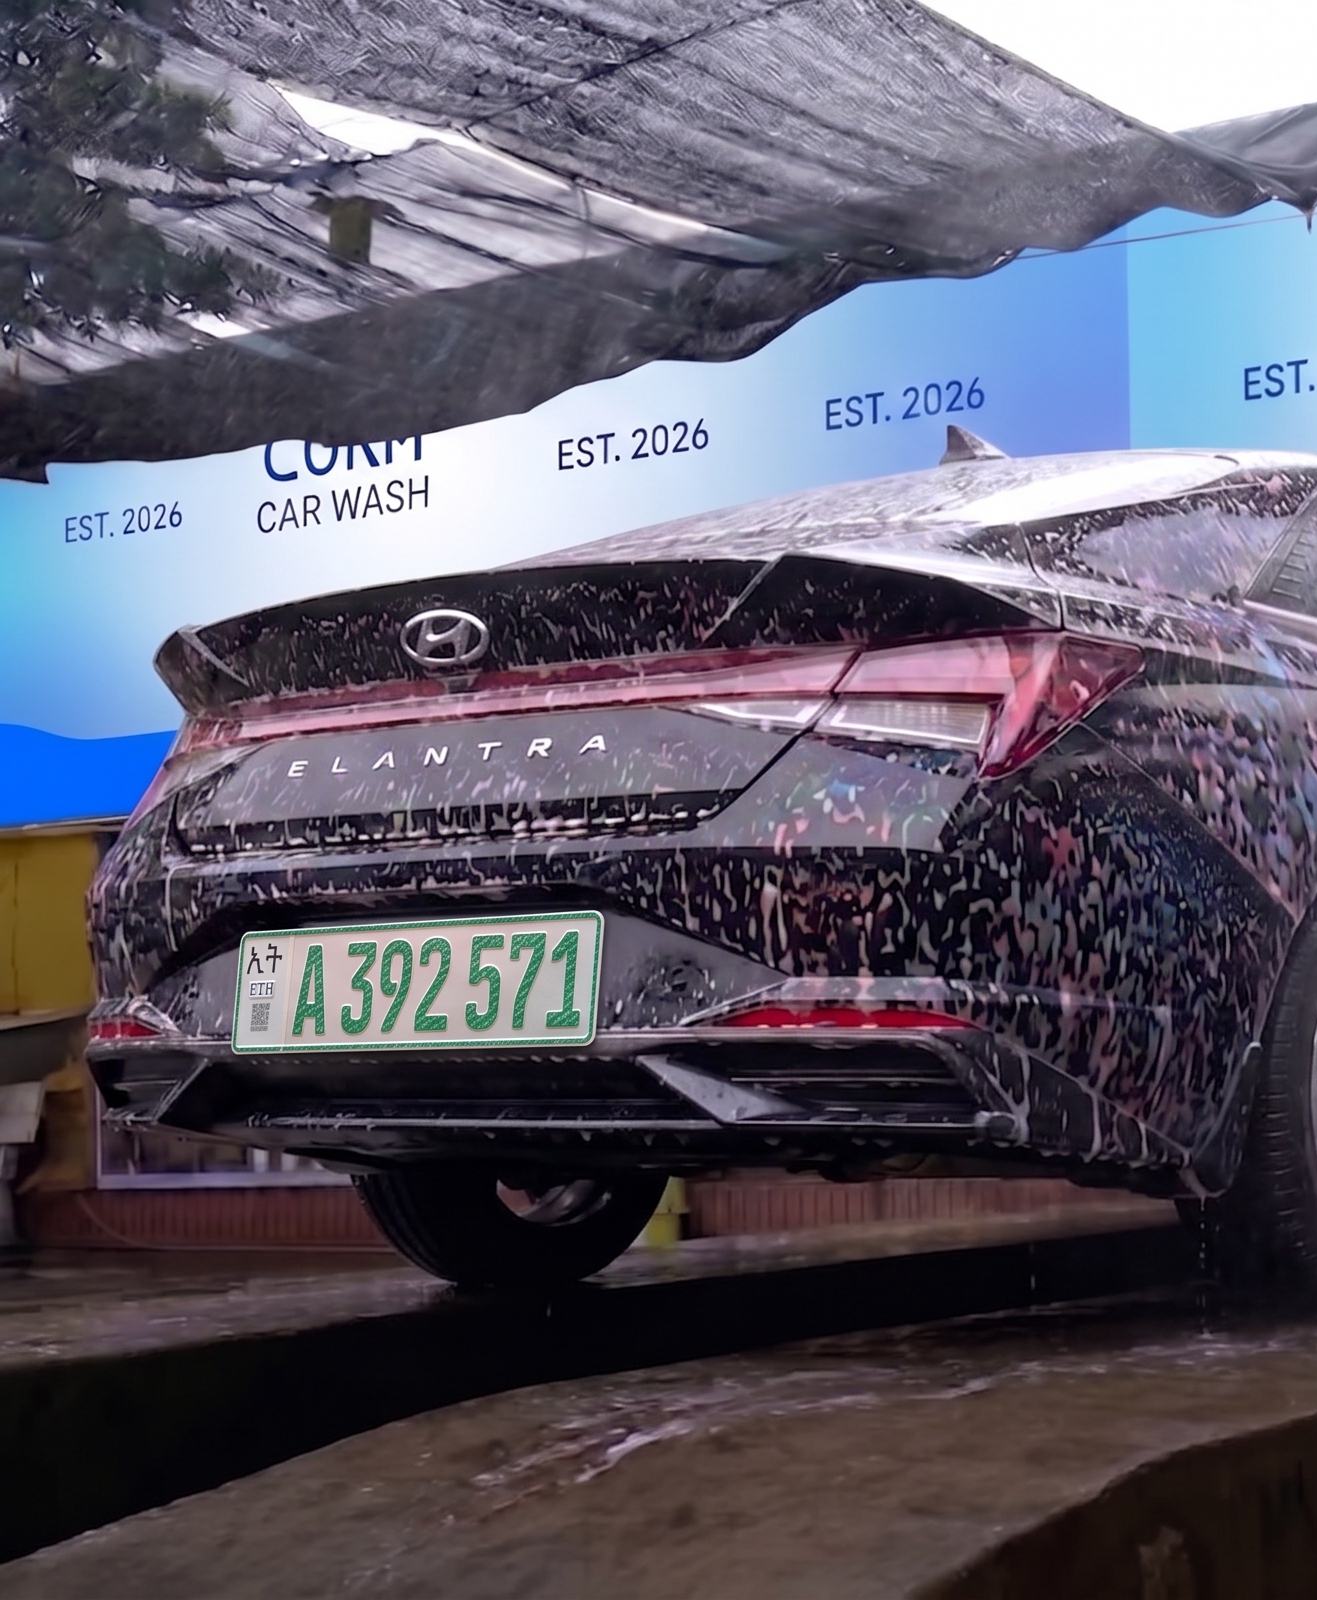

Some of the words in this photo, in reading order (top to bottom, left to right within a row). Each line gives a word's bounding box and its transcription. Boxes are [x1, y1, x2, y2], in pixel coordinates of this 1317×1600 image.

[825, 391, 892, 431] EST.
[902, 377, 986, 421] 2026
[1244, 359, 1316, 401] EST.
[558, 432, 622, 471] EST.
[631, 418, 709, 461] 2026
[65, 511, 116, 544] EST.
[122, 501, 183, 536] 2026
[257, 494, 321, 534] CAR
[331, 475, 429, 522] WASH
[287, 734, 607, 778] ELANTRA
[249, 982, 274, 996] ETH
[291, 943, 326, 1037] A
[340, 936, 452, 1036] 392
[465, 930, 581, 1031] 571
